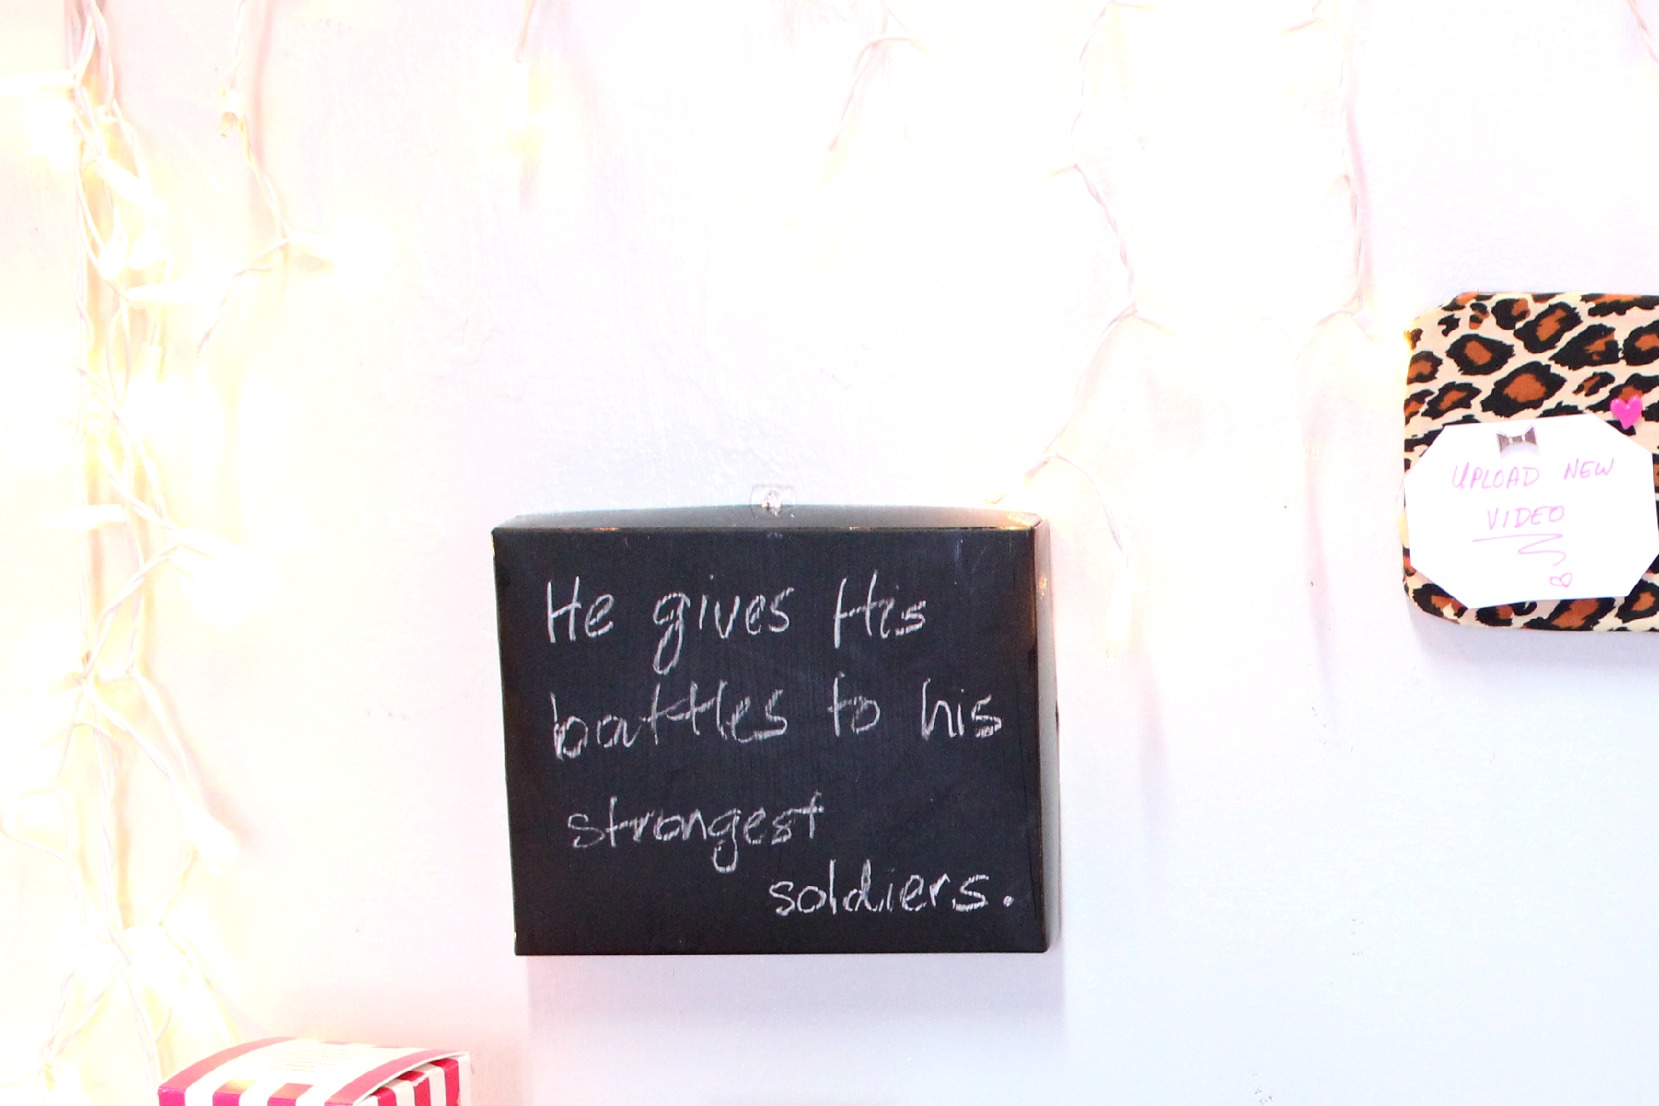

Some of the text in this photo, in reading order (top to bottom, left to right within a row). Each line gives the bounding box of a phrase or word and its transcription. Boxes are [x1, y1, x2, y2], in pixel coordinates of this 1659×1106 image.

[1452, 458, 1615, 490] UPLOAD NEW
[1487, 506, 1564, 530] VIDEO
[547, 570, 925, 674] He gives His
[550, 672, 1002, 760] battles to his
[568, 791, 824, 874] strongest
[769, 859, 1013, 916] soldiers.
